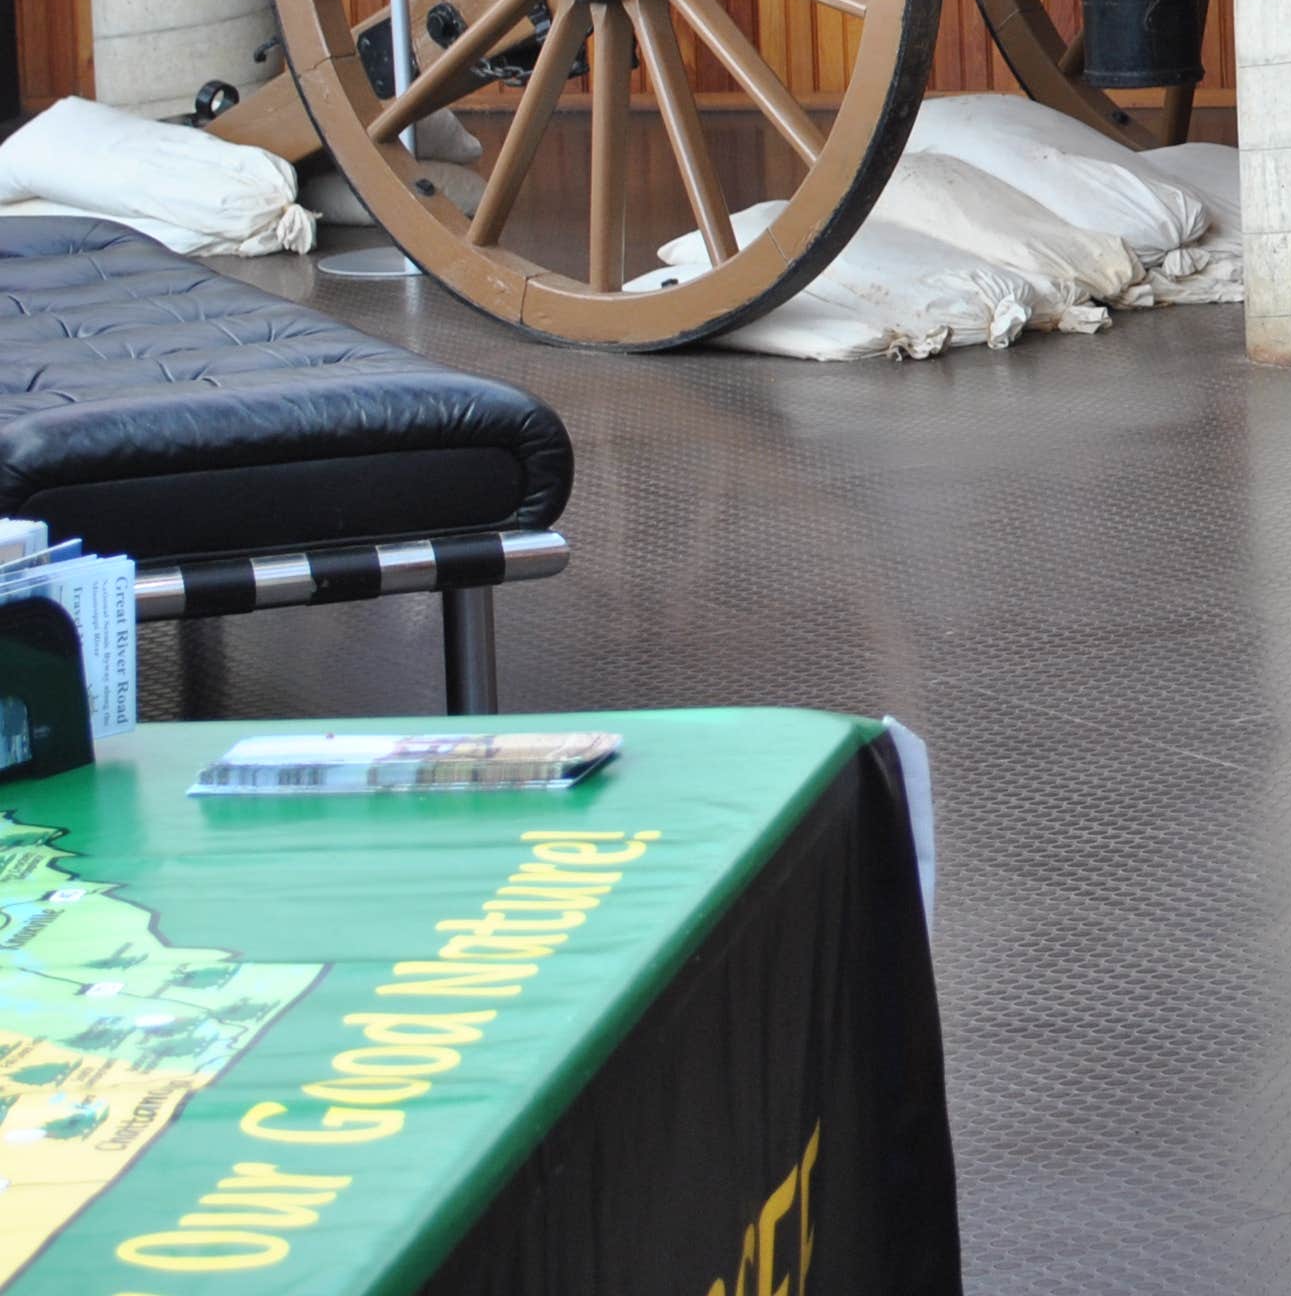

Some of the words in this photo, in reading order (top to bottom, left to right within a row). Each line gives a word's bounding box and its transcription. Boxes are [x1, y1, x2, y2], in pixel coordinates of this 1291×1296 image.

[115, 576, 128, 624] Great
[116, 630, 128, 674] River
[116, 682, 129, 724] Road
[115, 1161, 352, 1272] Our
[238, 1008, 497, 1146] Good
[375, 829, 662, 999] Nature!
